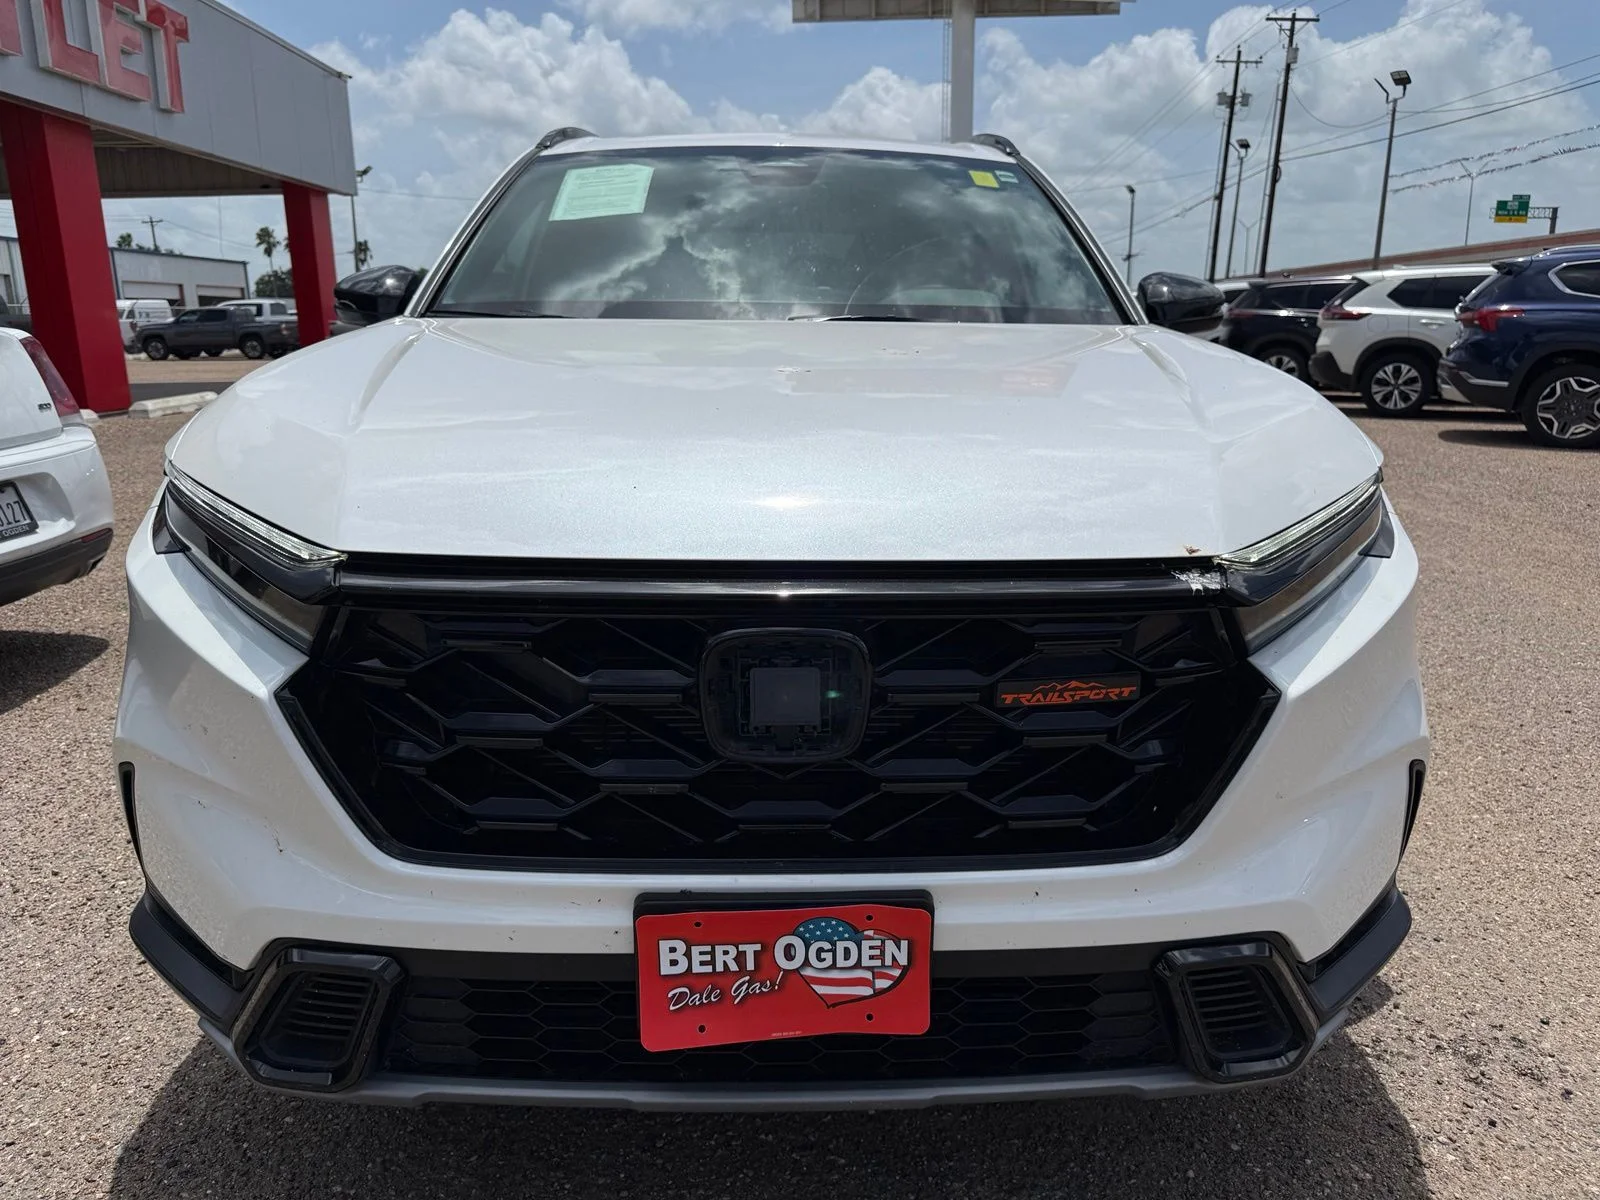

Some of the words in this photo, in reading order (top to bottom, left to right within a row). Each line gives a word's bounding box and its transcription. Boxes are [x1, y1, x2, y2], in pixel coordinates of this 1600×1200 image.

[0, 0, 190, 113] LET
[1001, 686, 1137, 705] TRAILSPORT
[657, 938, 763, 976] BERT
[773, 934, 910, 971] OGDEN
[667, 986, 721, 1012] Dale
[730, 970, 785, 1005] Gas!
